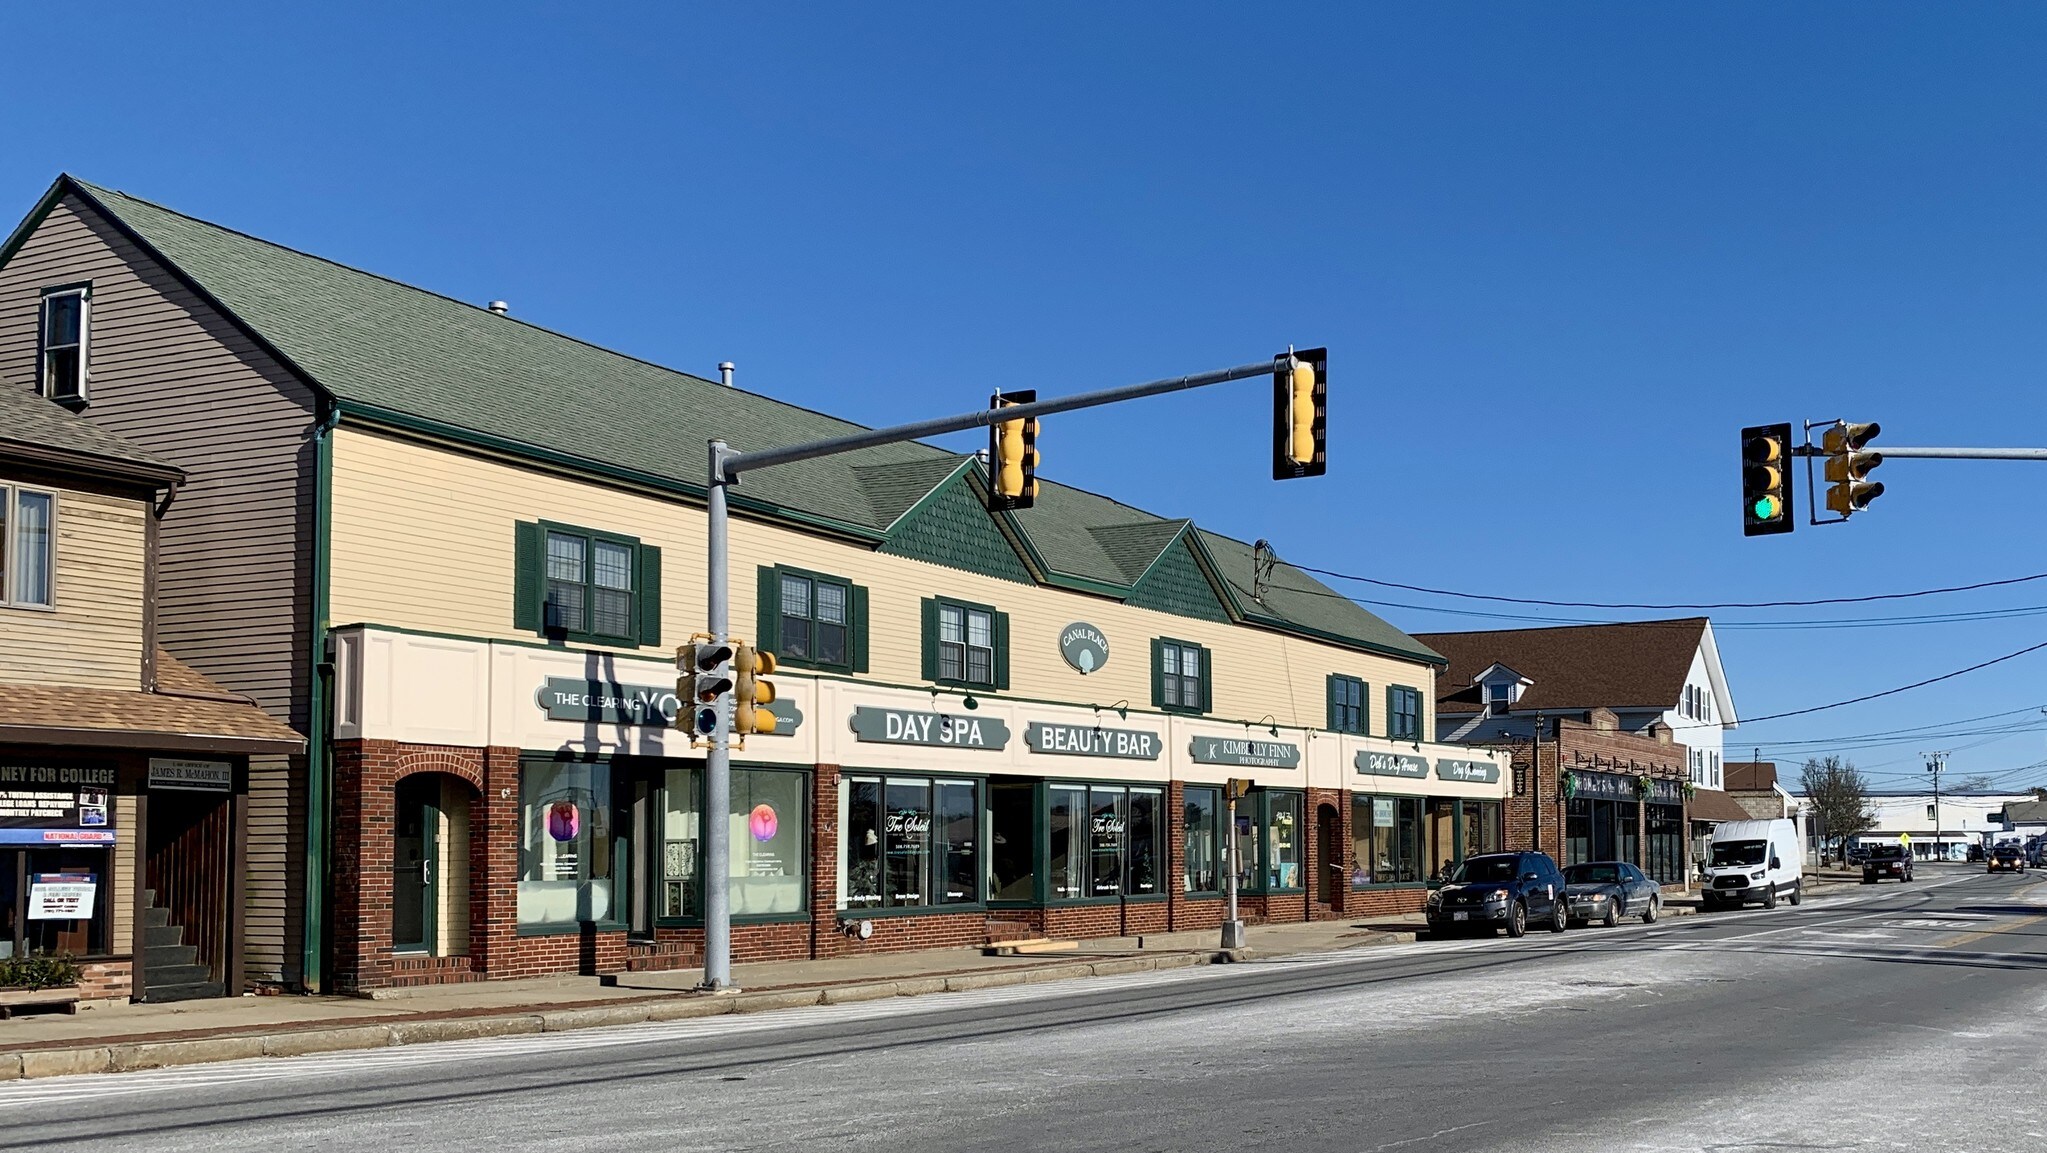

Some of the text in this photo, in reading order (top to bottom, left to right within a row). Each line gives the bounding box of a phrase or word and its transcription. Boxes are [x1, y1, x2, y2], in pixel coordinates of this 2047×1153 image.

[1063, 629, 1109, 654] CANAL PLACE
[554, 691, 682, 722] THE CLEARING YO
[886, 712, 984, 746] DAY SPA
[1041, 726, 1151, 756] BEAUTY BAR
[1223, 740, 1267, 757] KIMBERLY
[1269, 744, 1291, 758] FINN
[1239, 756, 1280, 767] PHOTOGRAPHY
[1370, 755, 1419, 775] Deb's Dog House
[1452, 761, 1464, 779] Dog
[1, 766, 115, 784] NEY FOR COLLEGE
[151, 767, 175, 778] JAMES
[8, 791, 34, 799] TUITION
[34, 792, 74, 800] ASSISTANCE
[15, 800, 37, 808] LOANS
[38, 801, 75, 809] REPAYMENT
[30, 809, 64, 817] PAYCHECK
[44, 832, 79, 840] NATIONAL
[79, 832, 103, 840] GUARD
[885, 815, 930, 840] Tre Soleil
